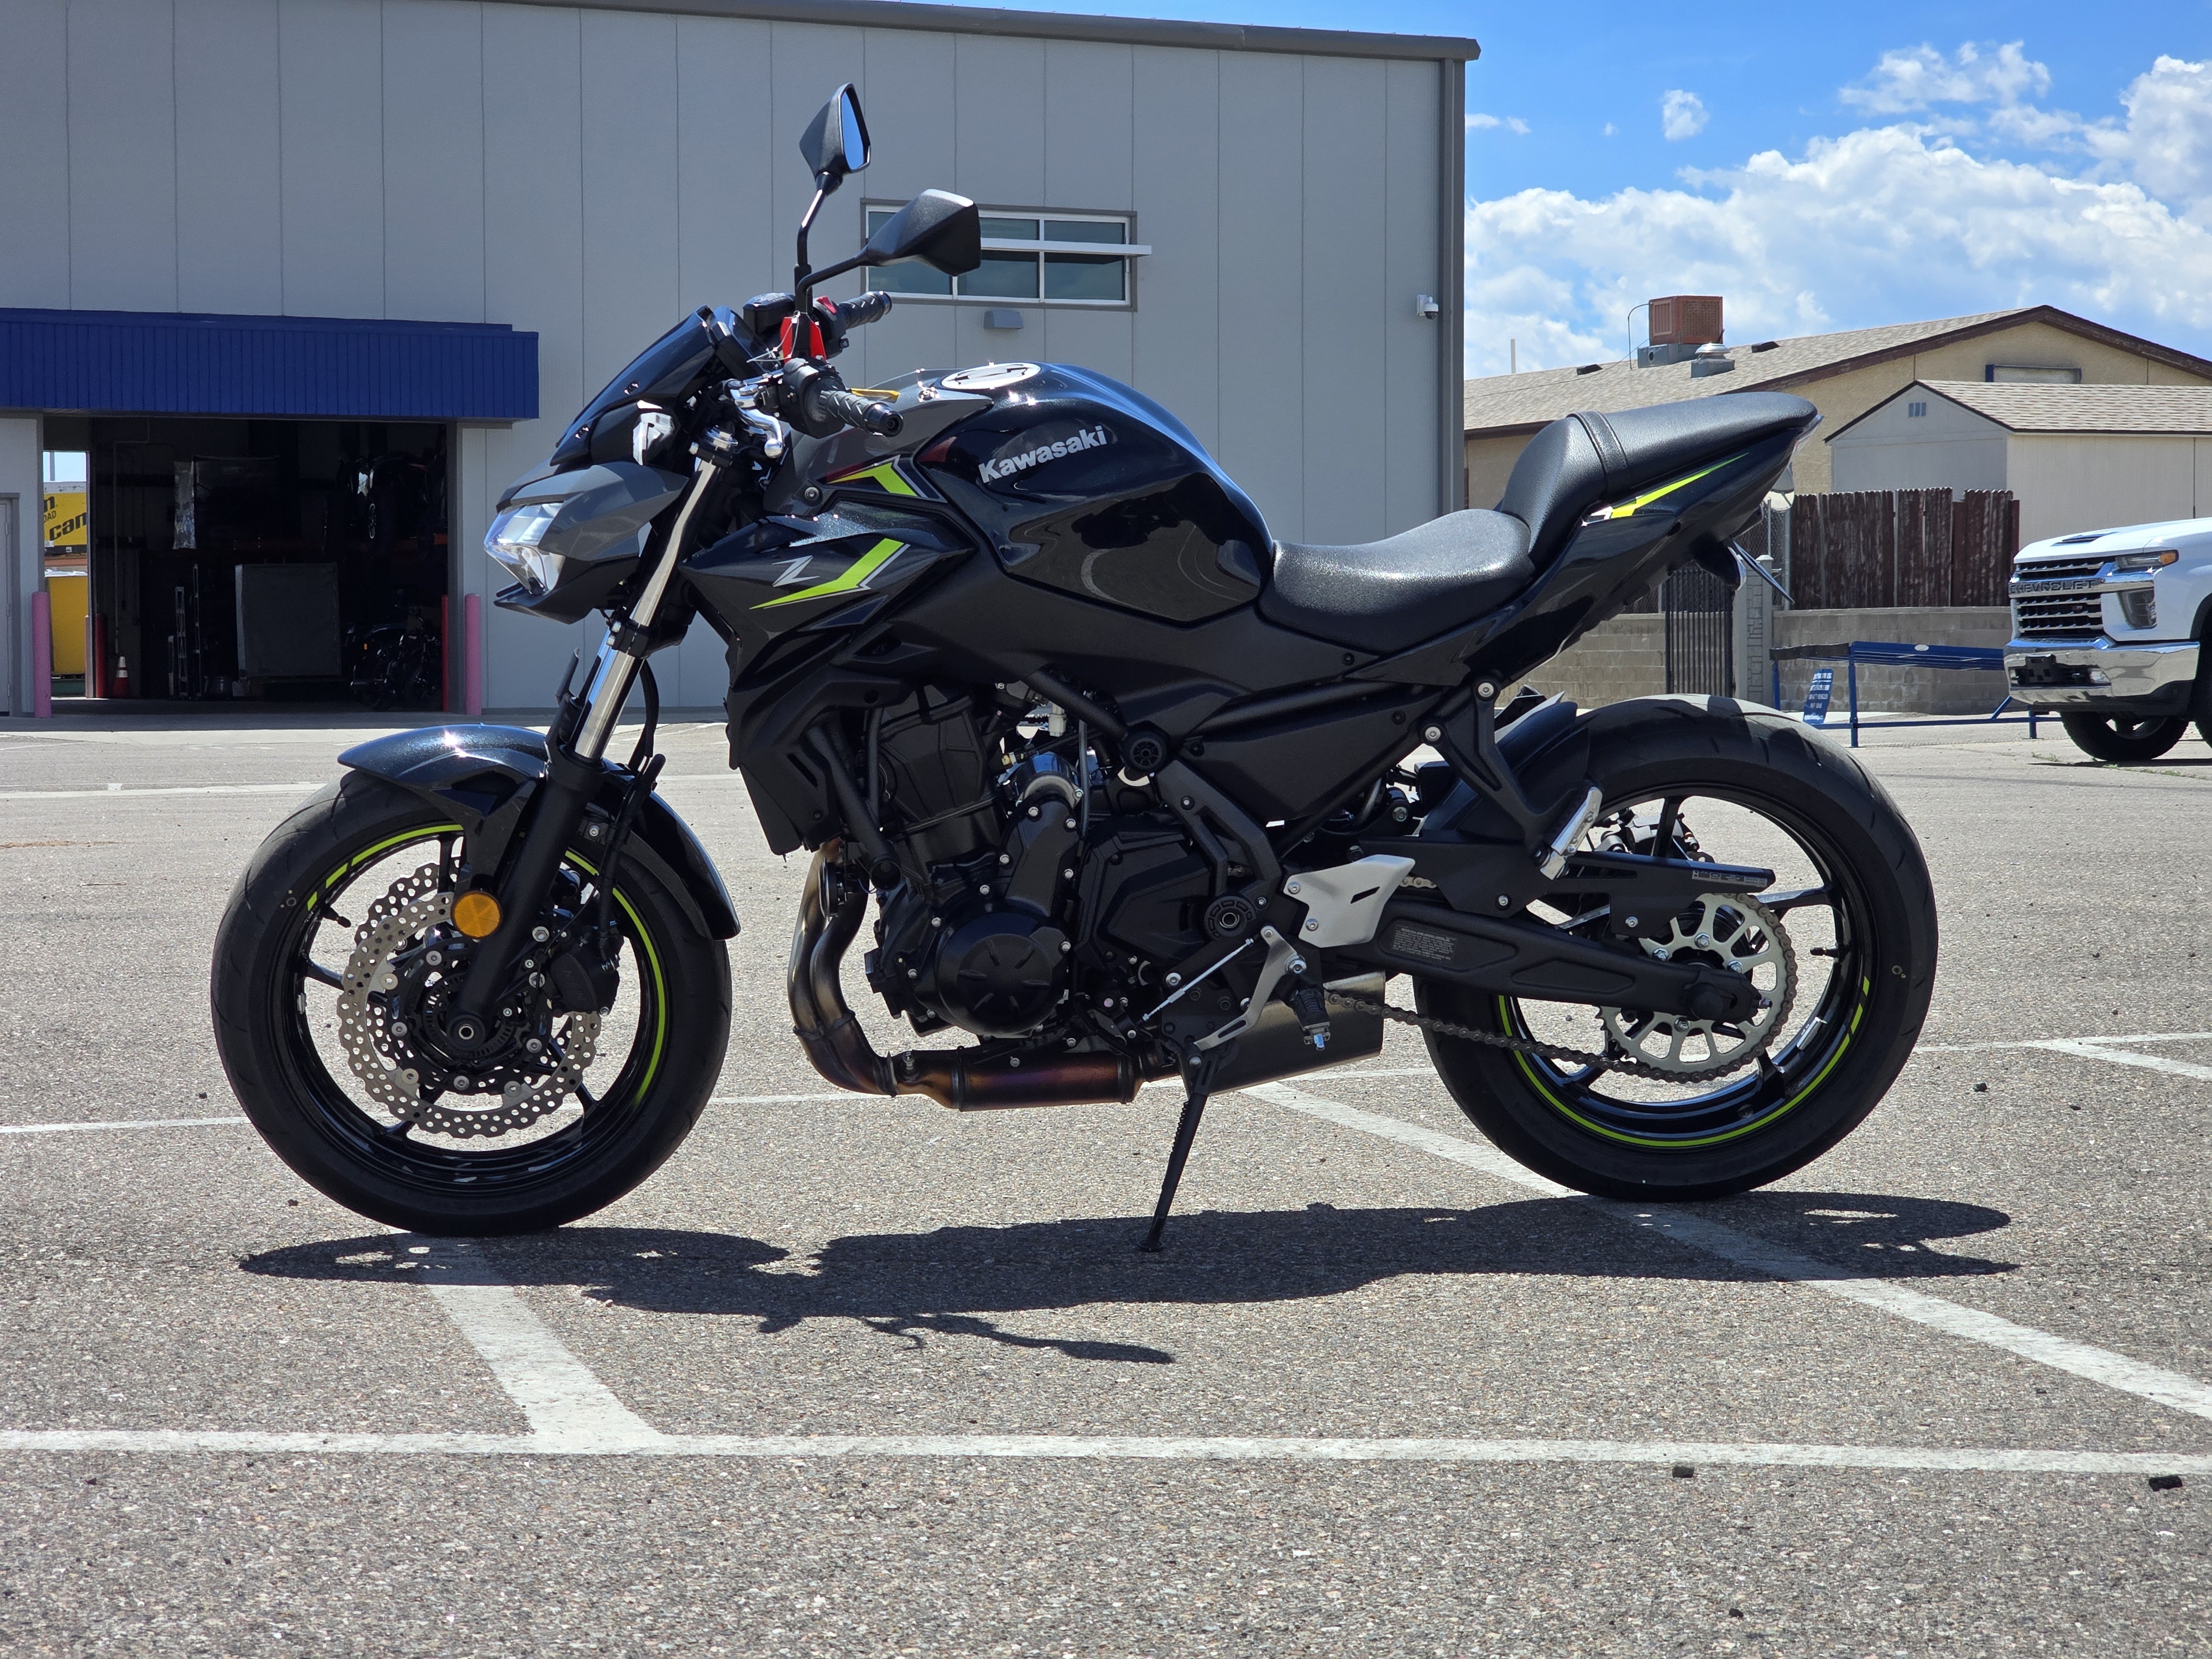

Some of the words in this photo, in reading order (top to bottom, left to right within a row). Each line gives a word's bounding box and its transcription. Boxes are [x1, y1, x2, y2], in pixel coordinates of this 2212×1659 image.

[978, 426, 1107, 483] Kawasaki
[771, 555, 820, 588] Z
[2010, 580, 2096, 594] CHEVROLET
